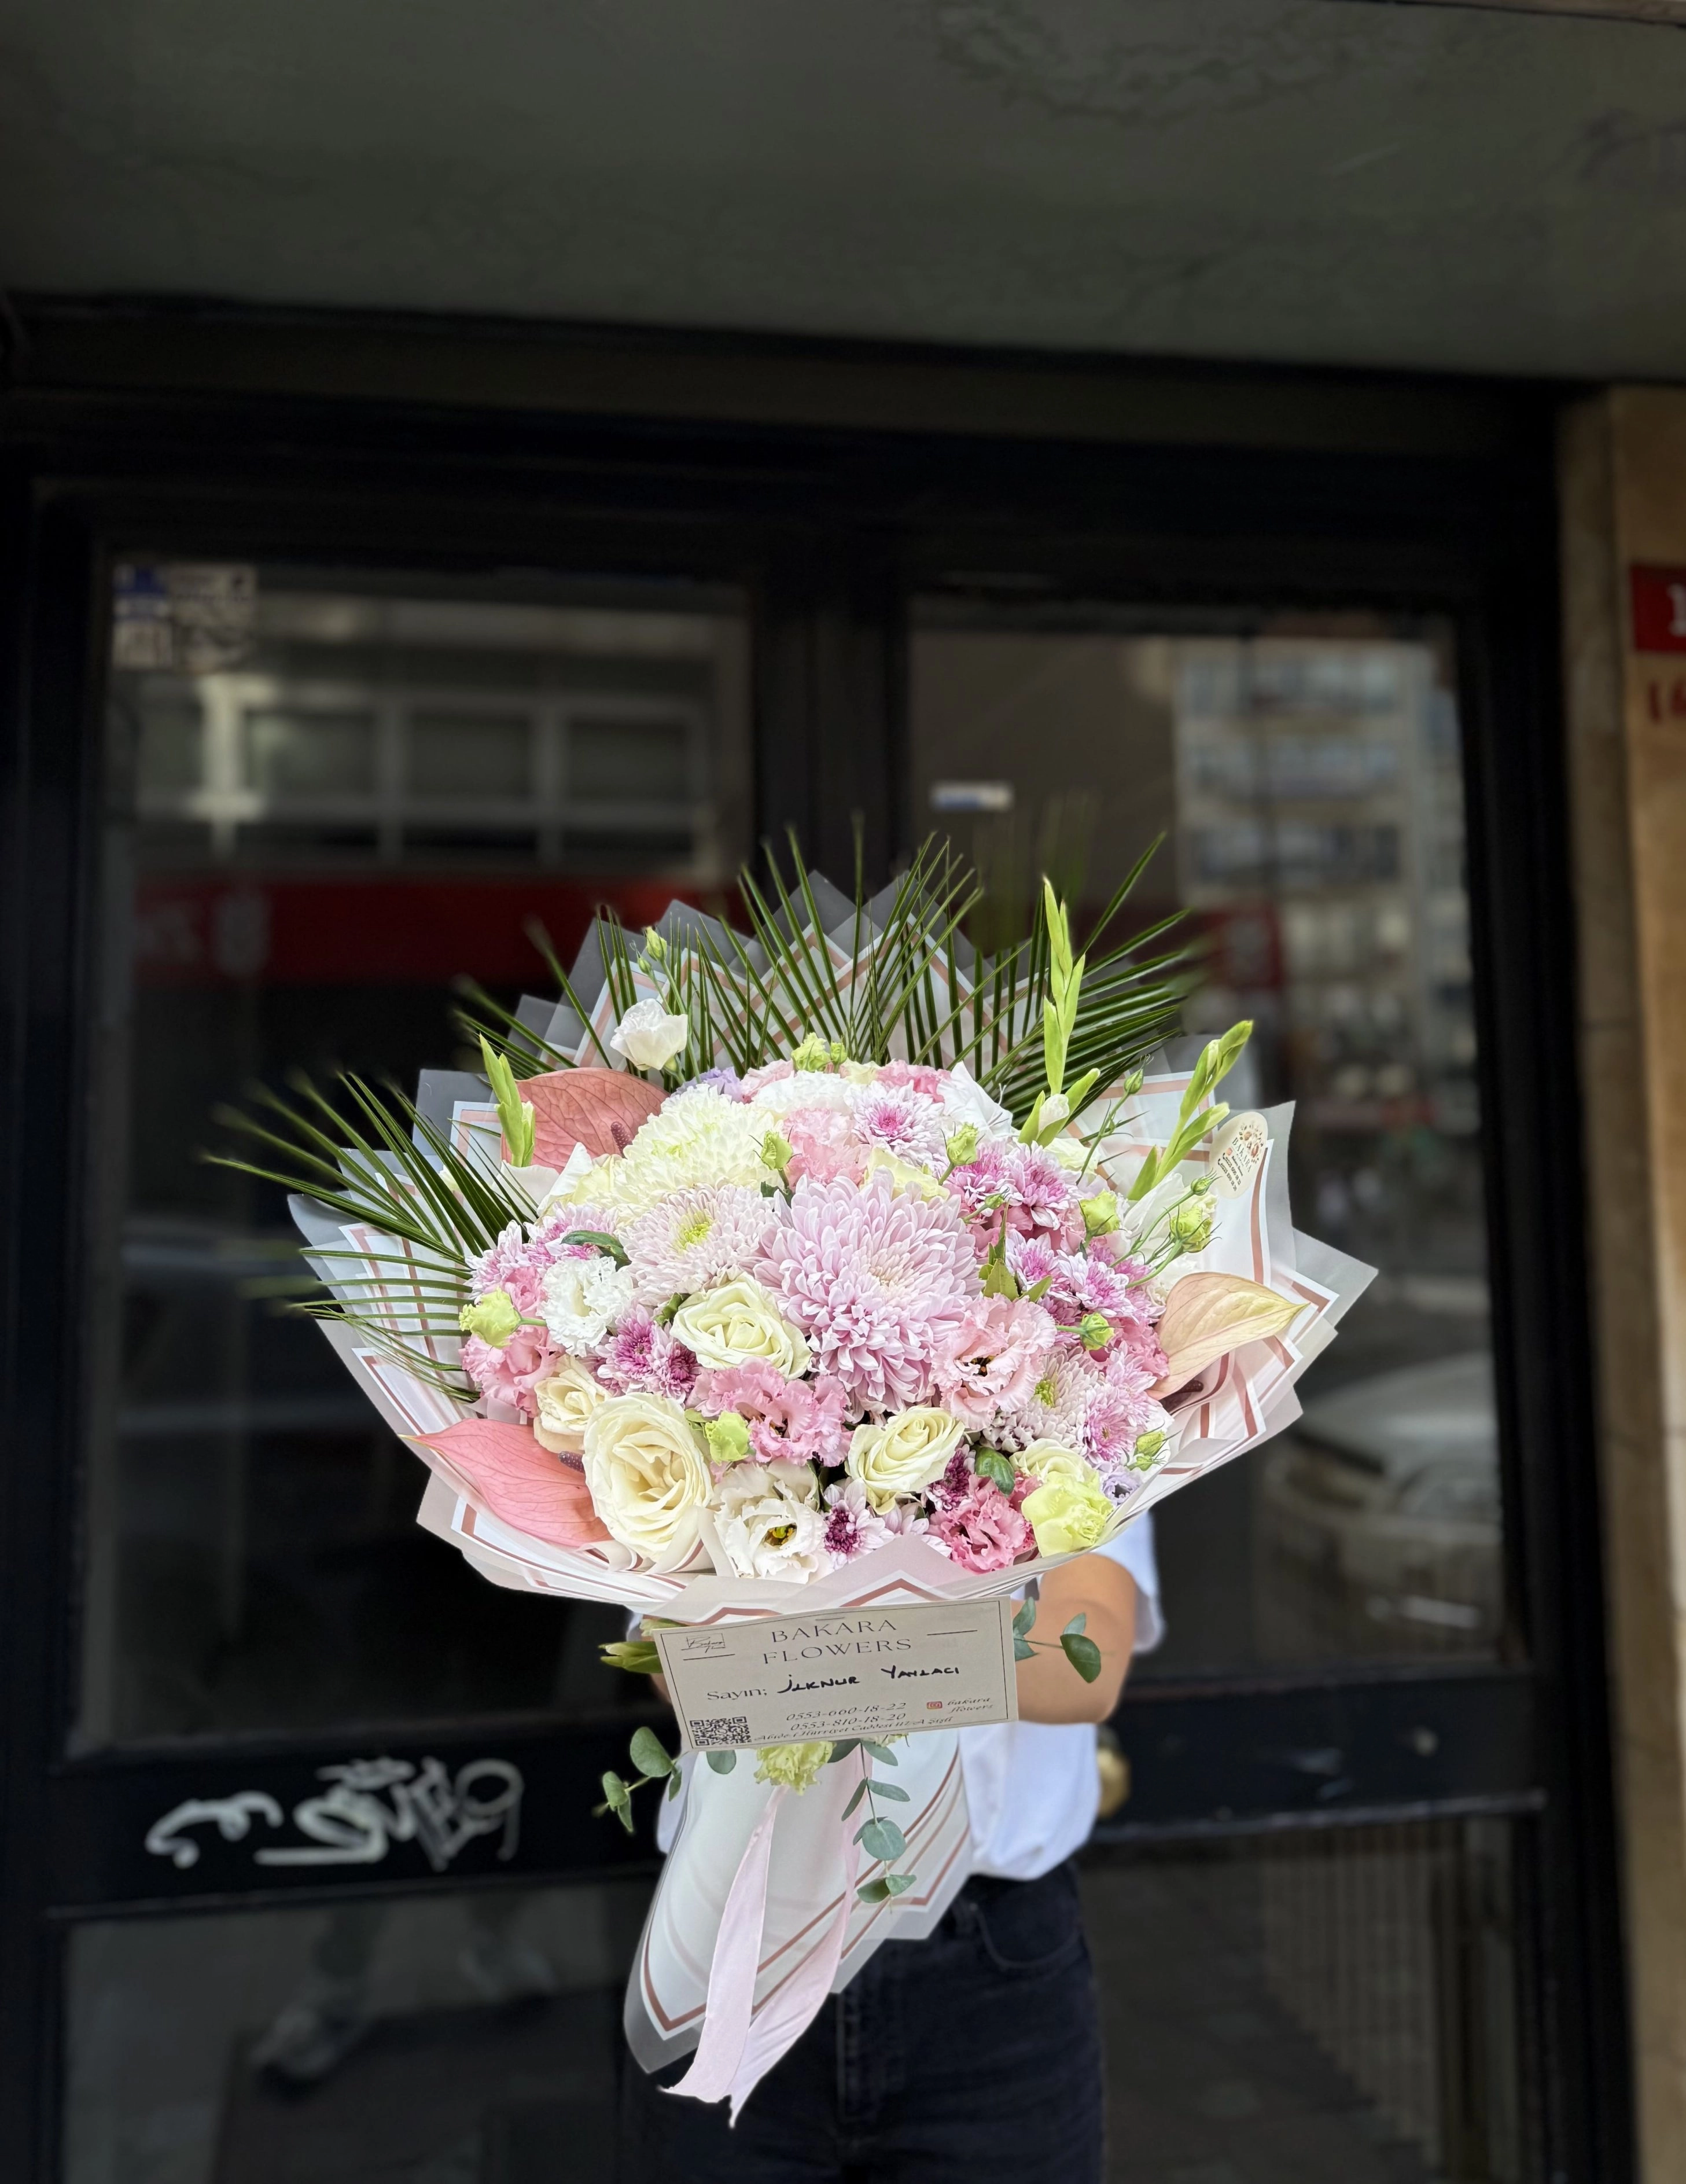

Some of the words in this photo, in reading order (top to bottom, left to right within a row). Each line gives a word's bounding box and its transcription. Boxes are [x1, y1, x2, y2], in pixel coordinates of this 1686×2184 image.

[771, 1619, 897, 1643] BAKARA
[763, 1638, 912, 1664] FLOWERS
[786, 1702, 907, 1721] 0553-660-18-22
[790, 1713, 906, 1731] 0553-810-18-20
